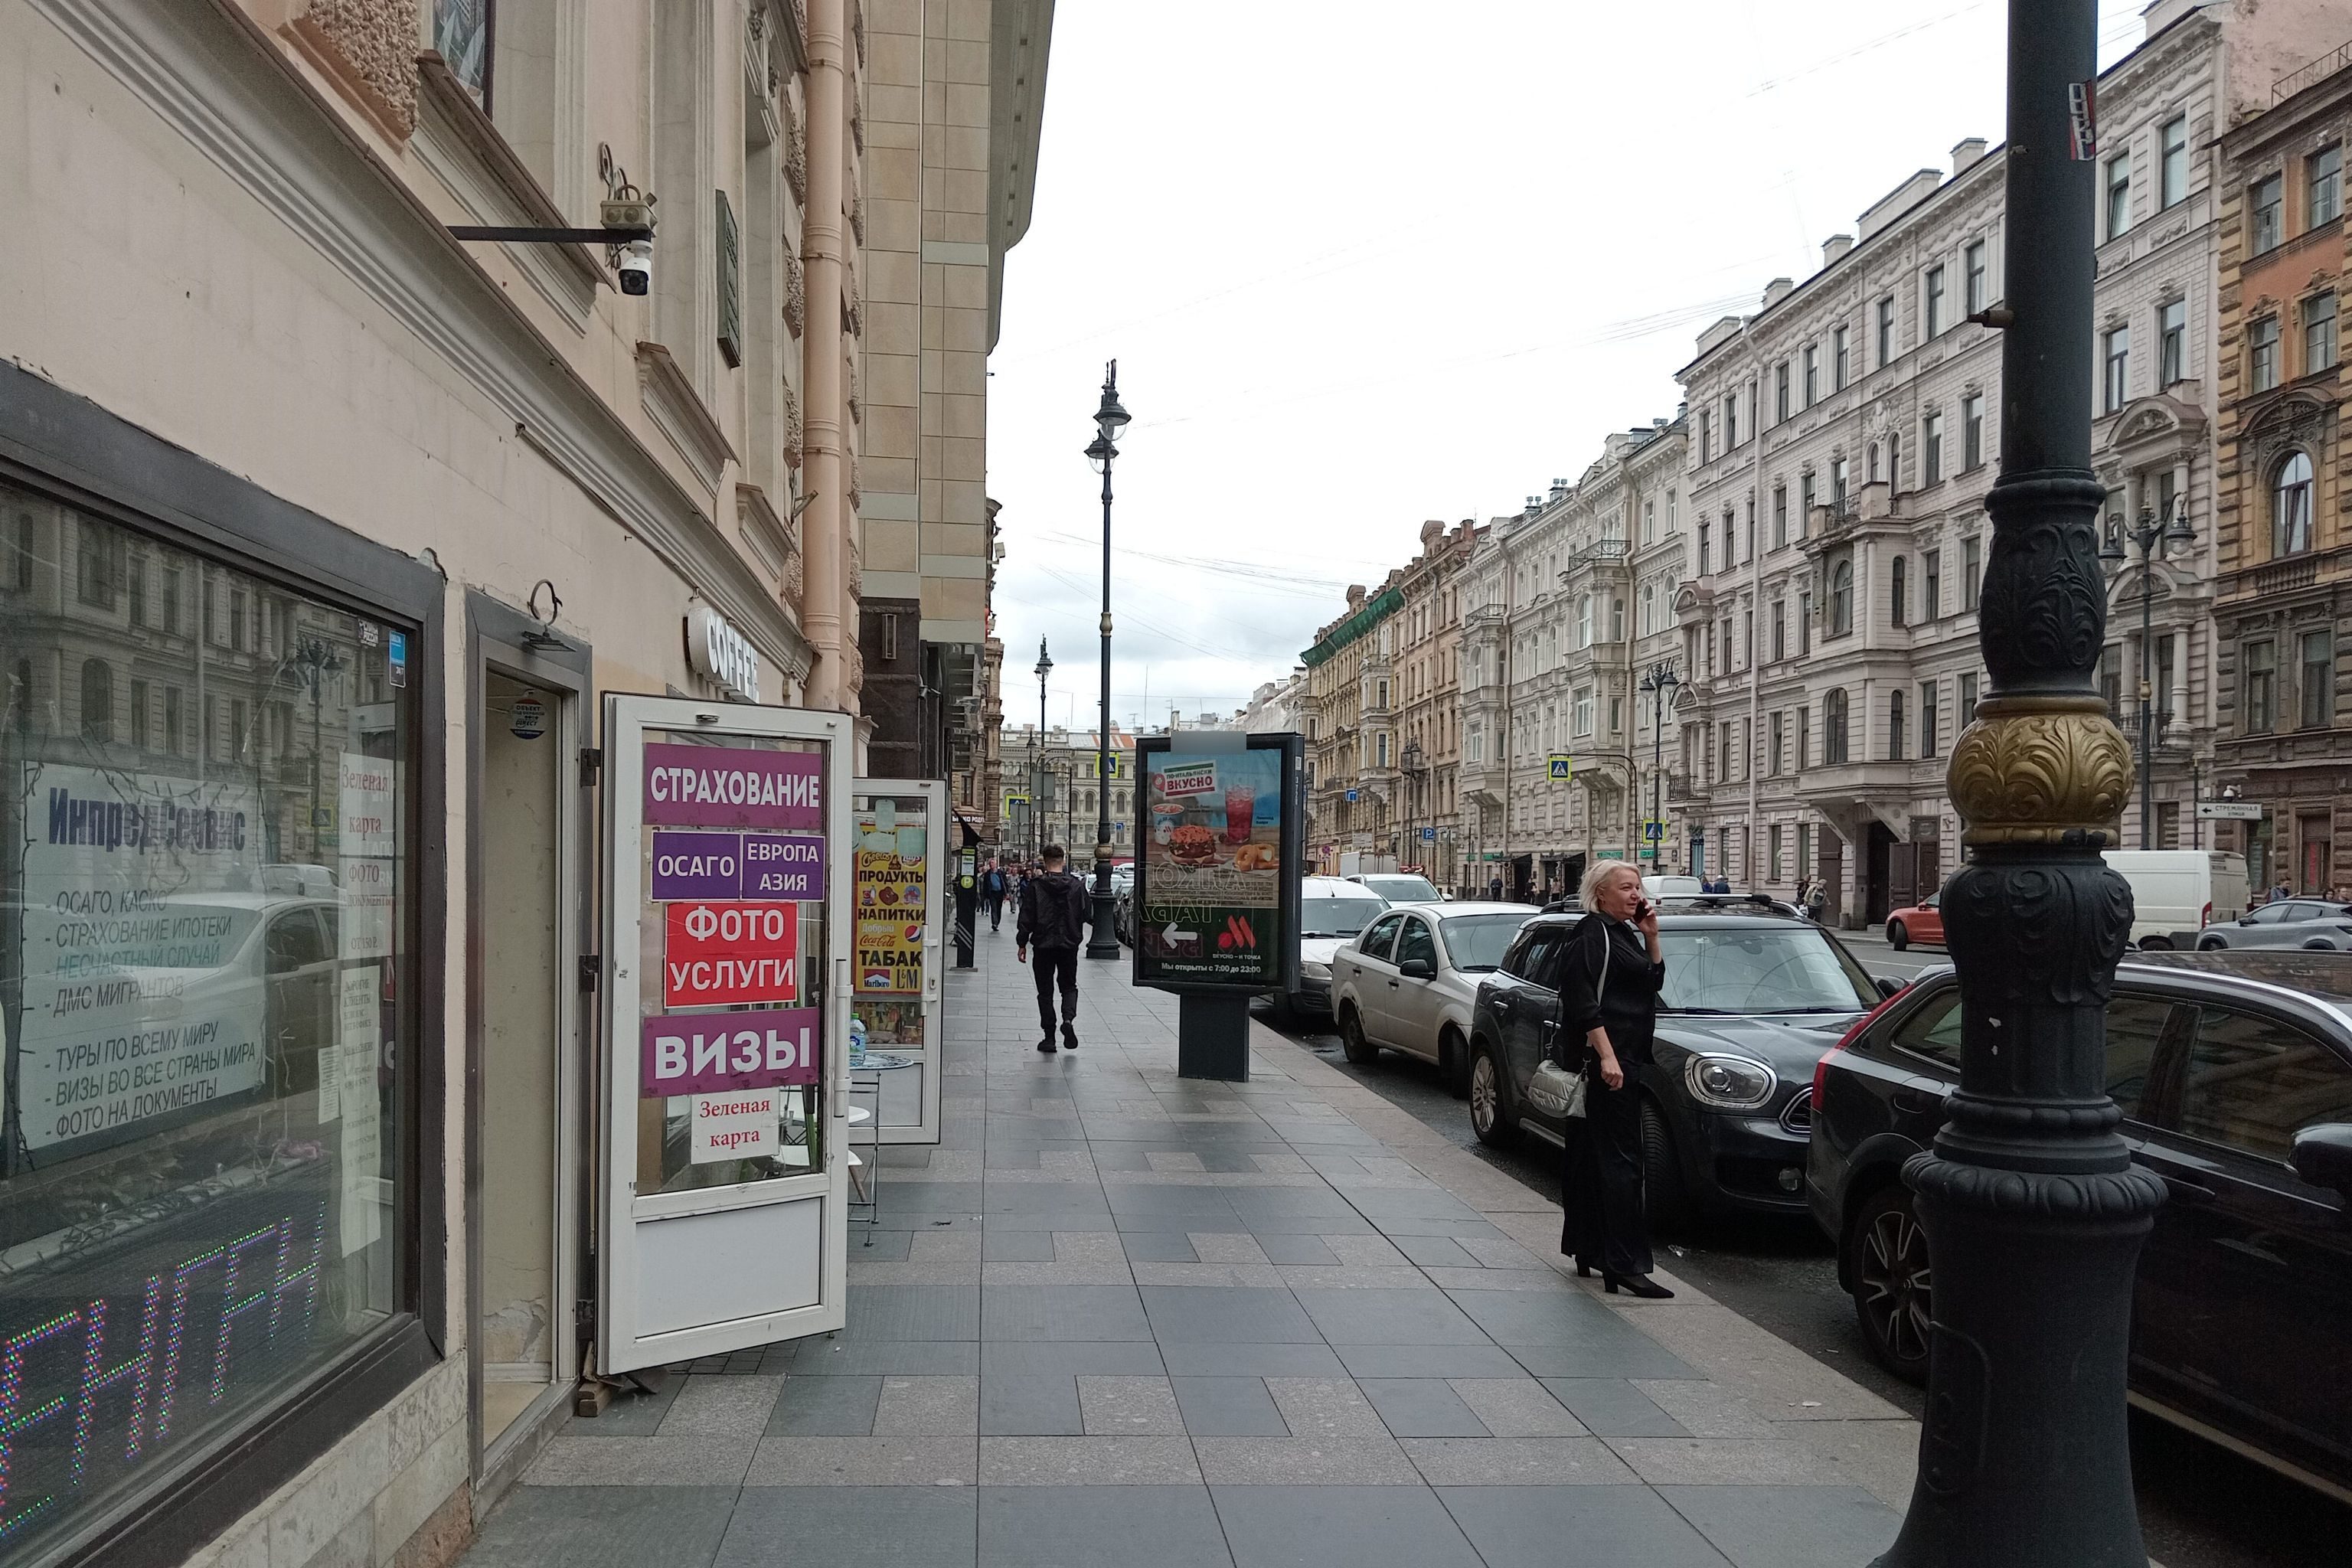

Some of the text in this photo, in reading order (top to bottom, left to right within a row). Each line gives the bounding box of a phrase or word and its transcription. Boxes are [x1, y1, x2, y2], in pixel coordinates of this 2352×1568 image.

[688, 607, 760, 704] COFFEE
[342, 765, 389, 792] Зеленая
[1166, 769, 1212, 779] ПО-ИТАЛЬЯНСКИ
[1167, 776, 1213, 790] ВКУСНО
[651, 766, 819, 808] СТРАХОВАНИЕ
[349, 815, 381, 841] карта
[747, 843, 819, 862] ЕВРОПА
[349, 864, 379, 883] ФОТО
[658, 855, 735, 877] ОСАГО
[859, 870, 926, 884] ПРОДУКТЫ
[759, 874, 807, 891] АЗИЯ
[57, 890, 168, 916] ОСАГО, КАСКО
[685, 906, 784, 942] ФОТО
[858, 908, 925, 921] НАПИТКИ
[57, 916, 230, 947] СТРАХОВАНИЕ ИПОТЕКИ
[862, 923, 894, 933] Добрый
[56, 940, 220, 980] НЕСЧАСТНЫЙ СЛУЧАЙ
[859, 950, 922, 967] ТАБАК
[1161, 962, 1174, 970] Мы
[1174, 963, 1207, 972] открыты
[669, 959, 794, 991] УСЛУГИ
[864, 979, 890, 988] Marlboro
[897, 969, 917, 988] L&M
[54, 976, 184, 1018] ДМС МИГРАНТОВ
[57, 1021, 218, 1072] ТУРЫ ПО ВСЕМУ МИРУ
[655, 1027, 810, 1080] ВИЗЫ
[56, 1042, 255, 1106] ВИЗЫ ВО ВСЕ СТРАНЫ МИРА
[57, 1077, 217, 1138] ФОТО НА ДОКУМЕНТЫ
[700, 1099, 770, 1118] Зеленая
[710, 1130, 760, 1149] карта
